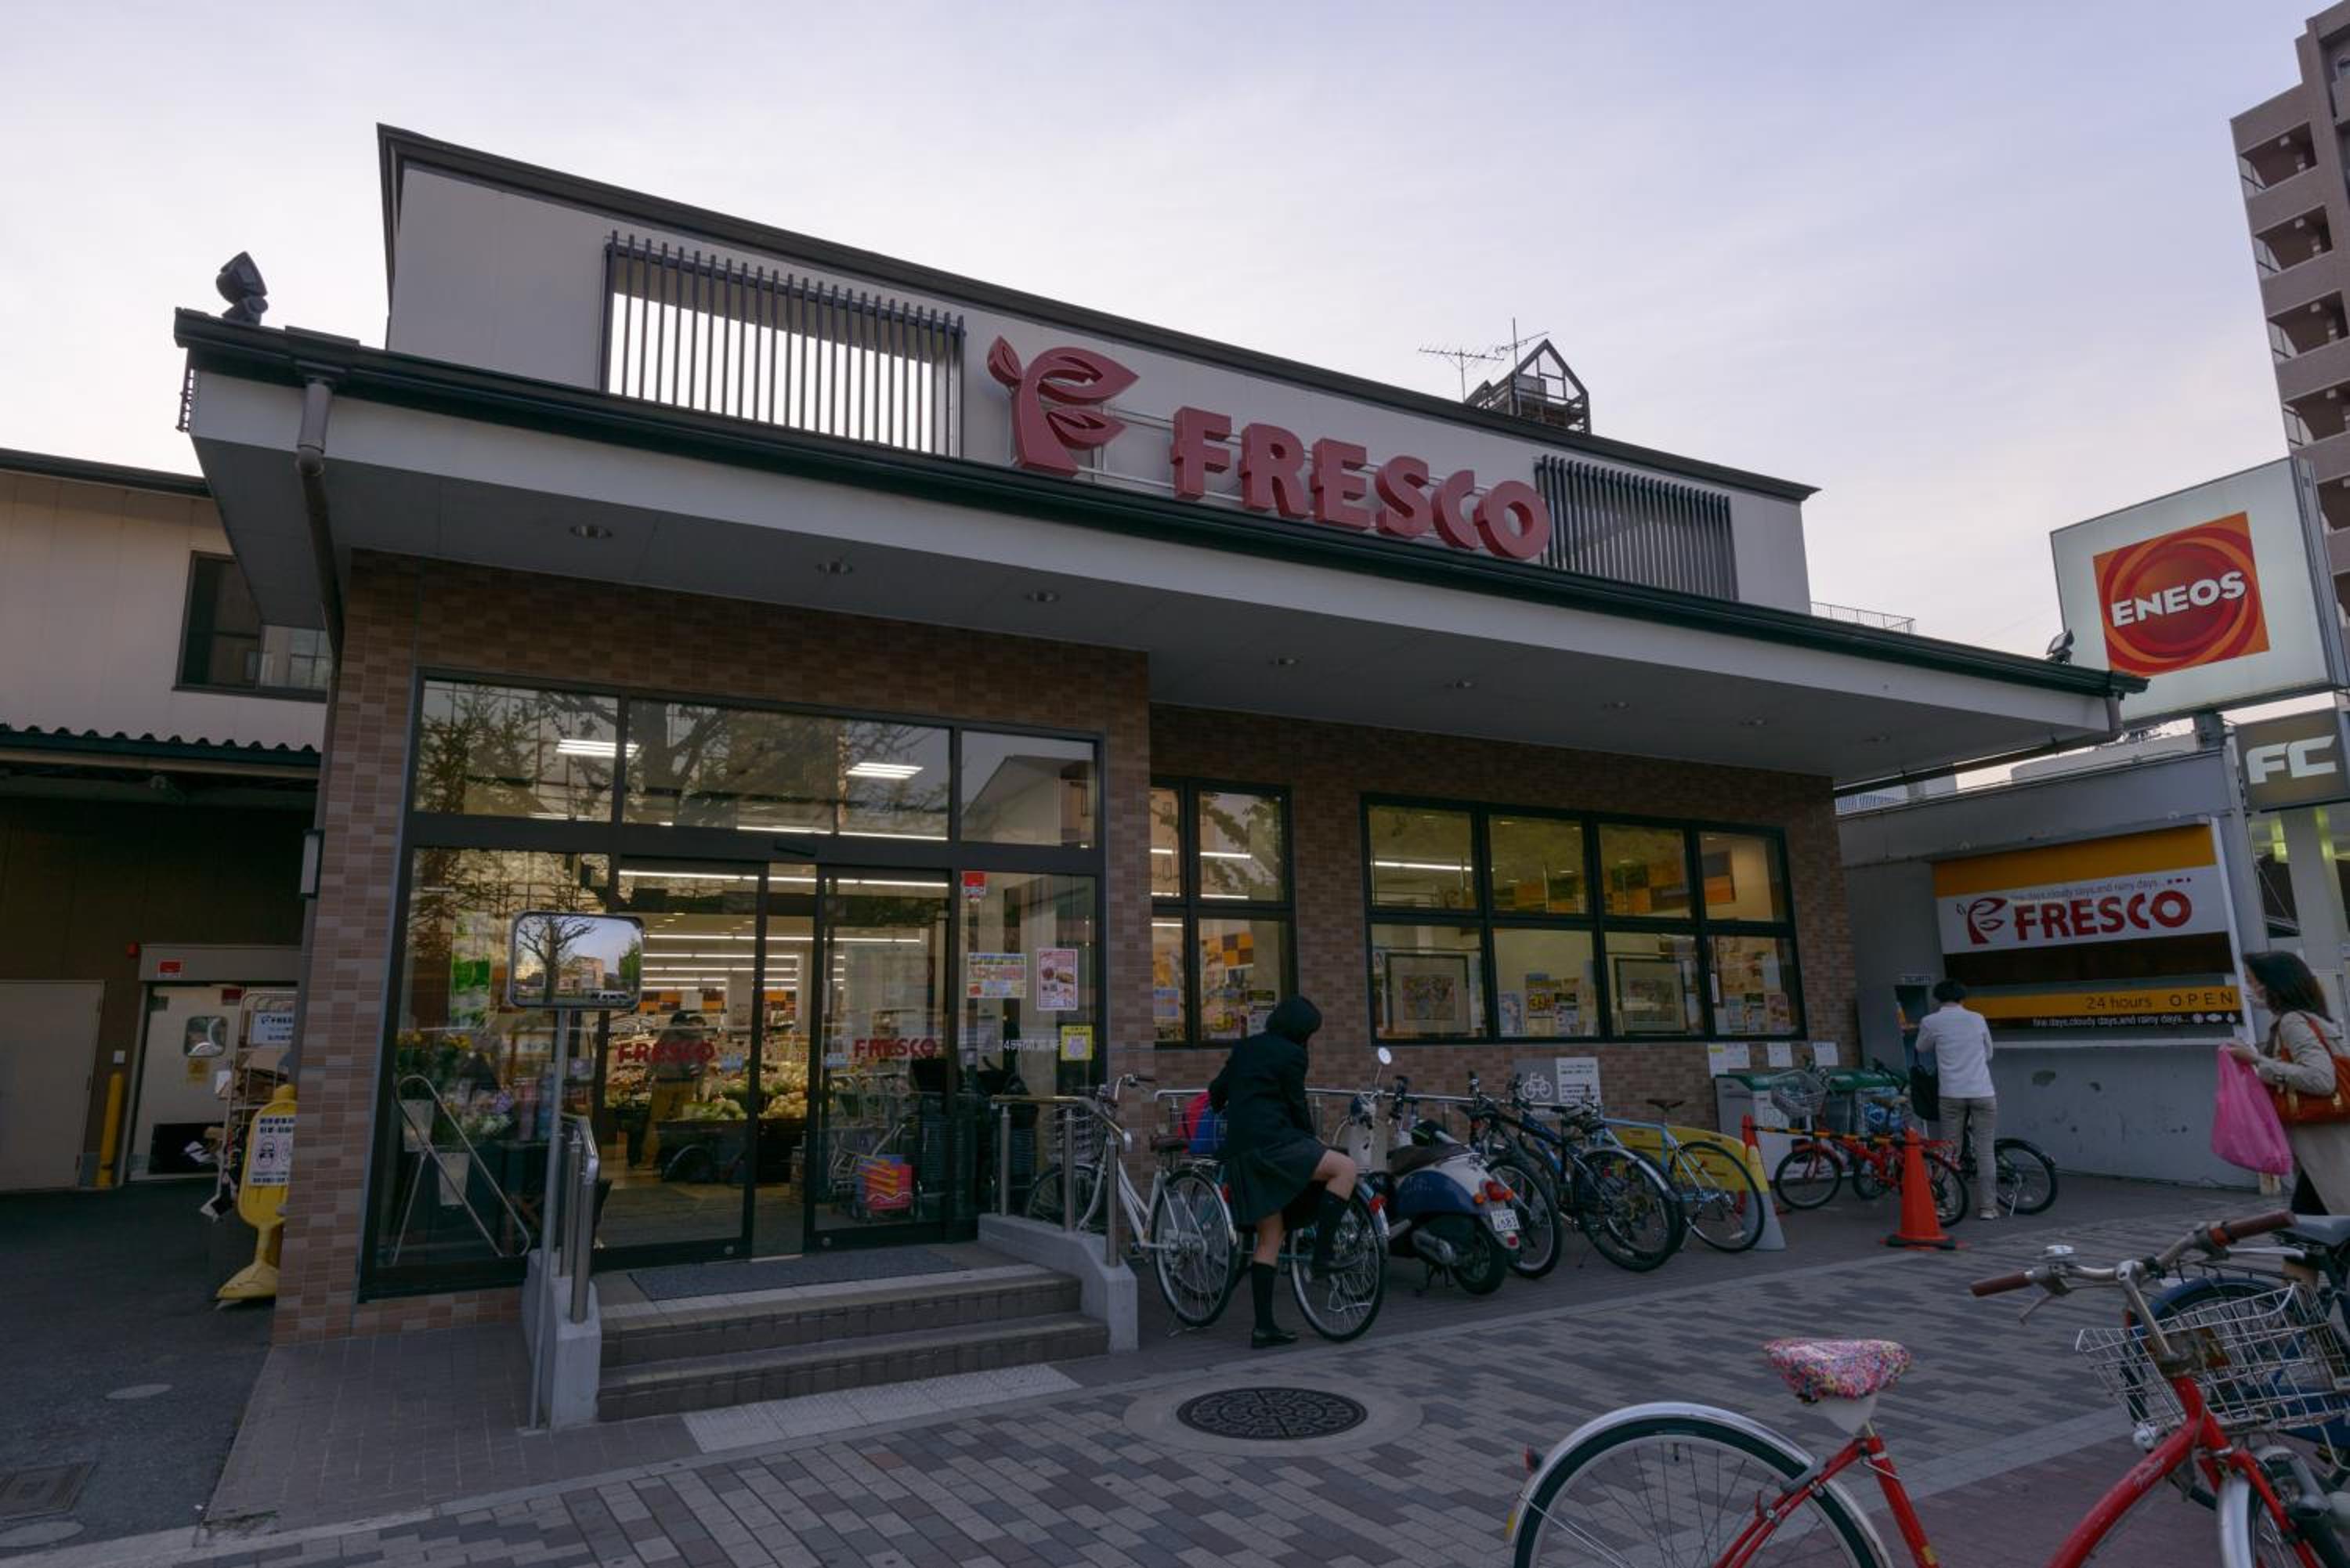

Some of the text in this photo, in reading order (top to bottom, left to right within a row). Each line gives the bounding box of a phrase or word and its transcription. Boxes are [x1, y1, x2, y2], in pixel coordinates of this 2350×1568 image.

[1170, 406, 1551, 560] FRESCO
[2110, 571, 2246, 627] ENEOS
[2246, 735, 2337, 784] FC
[2014, 890, 2192, 941] FRESCO
[2084, 991, 2234, 1010] 24 hours OPEN
[855, 1038, 937, 1057] FRESCO
